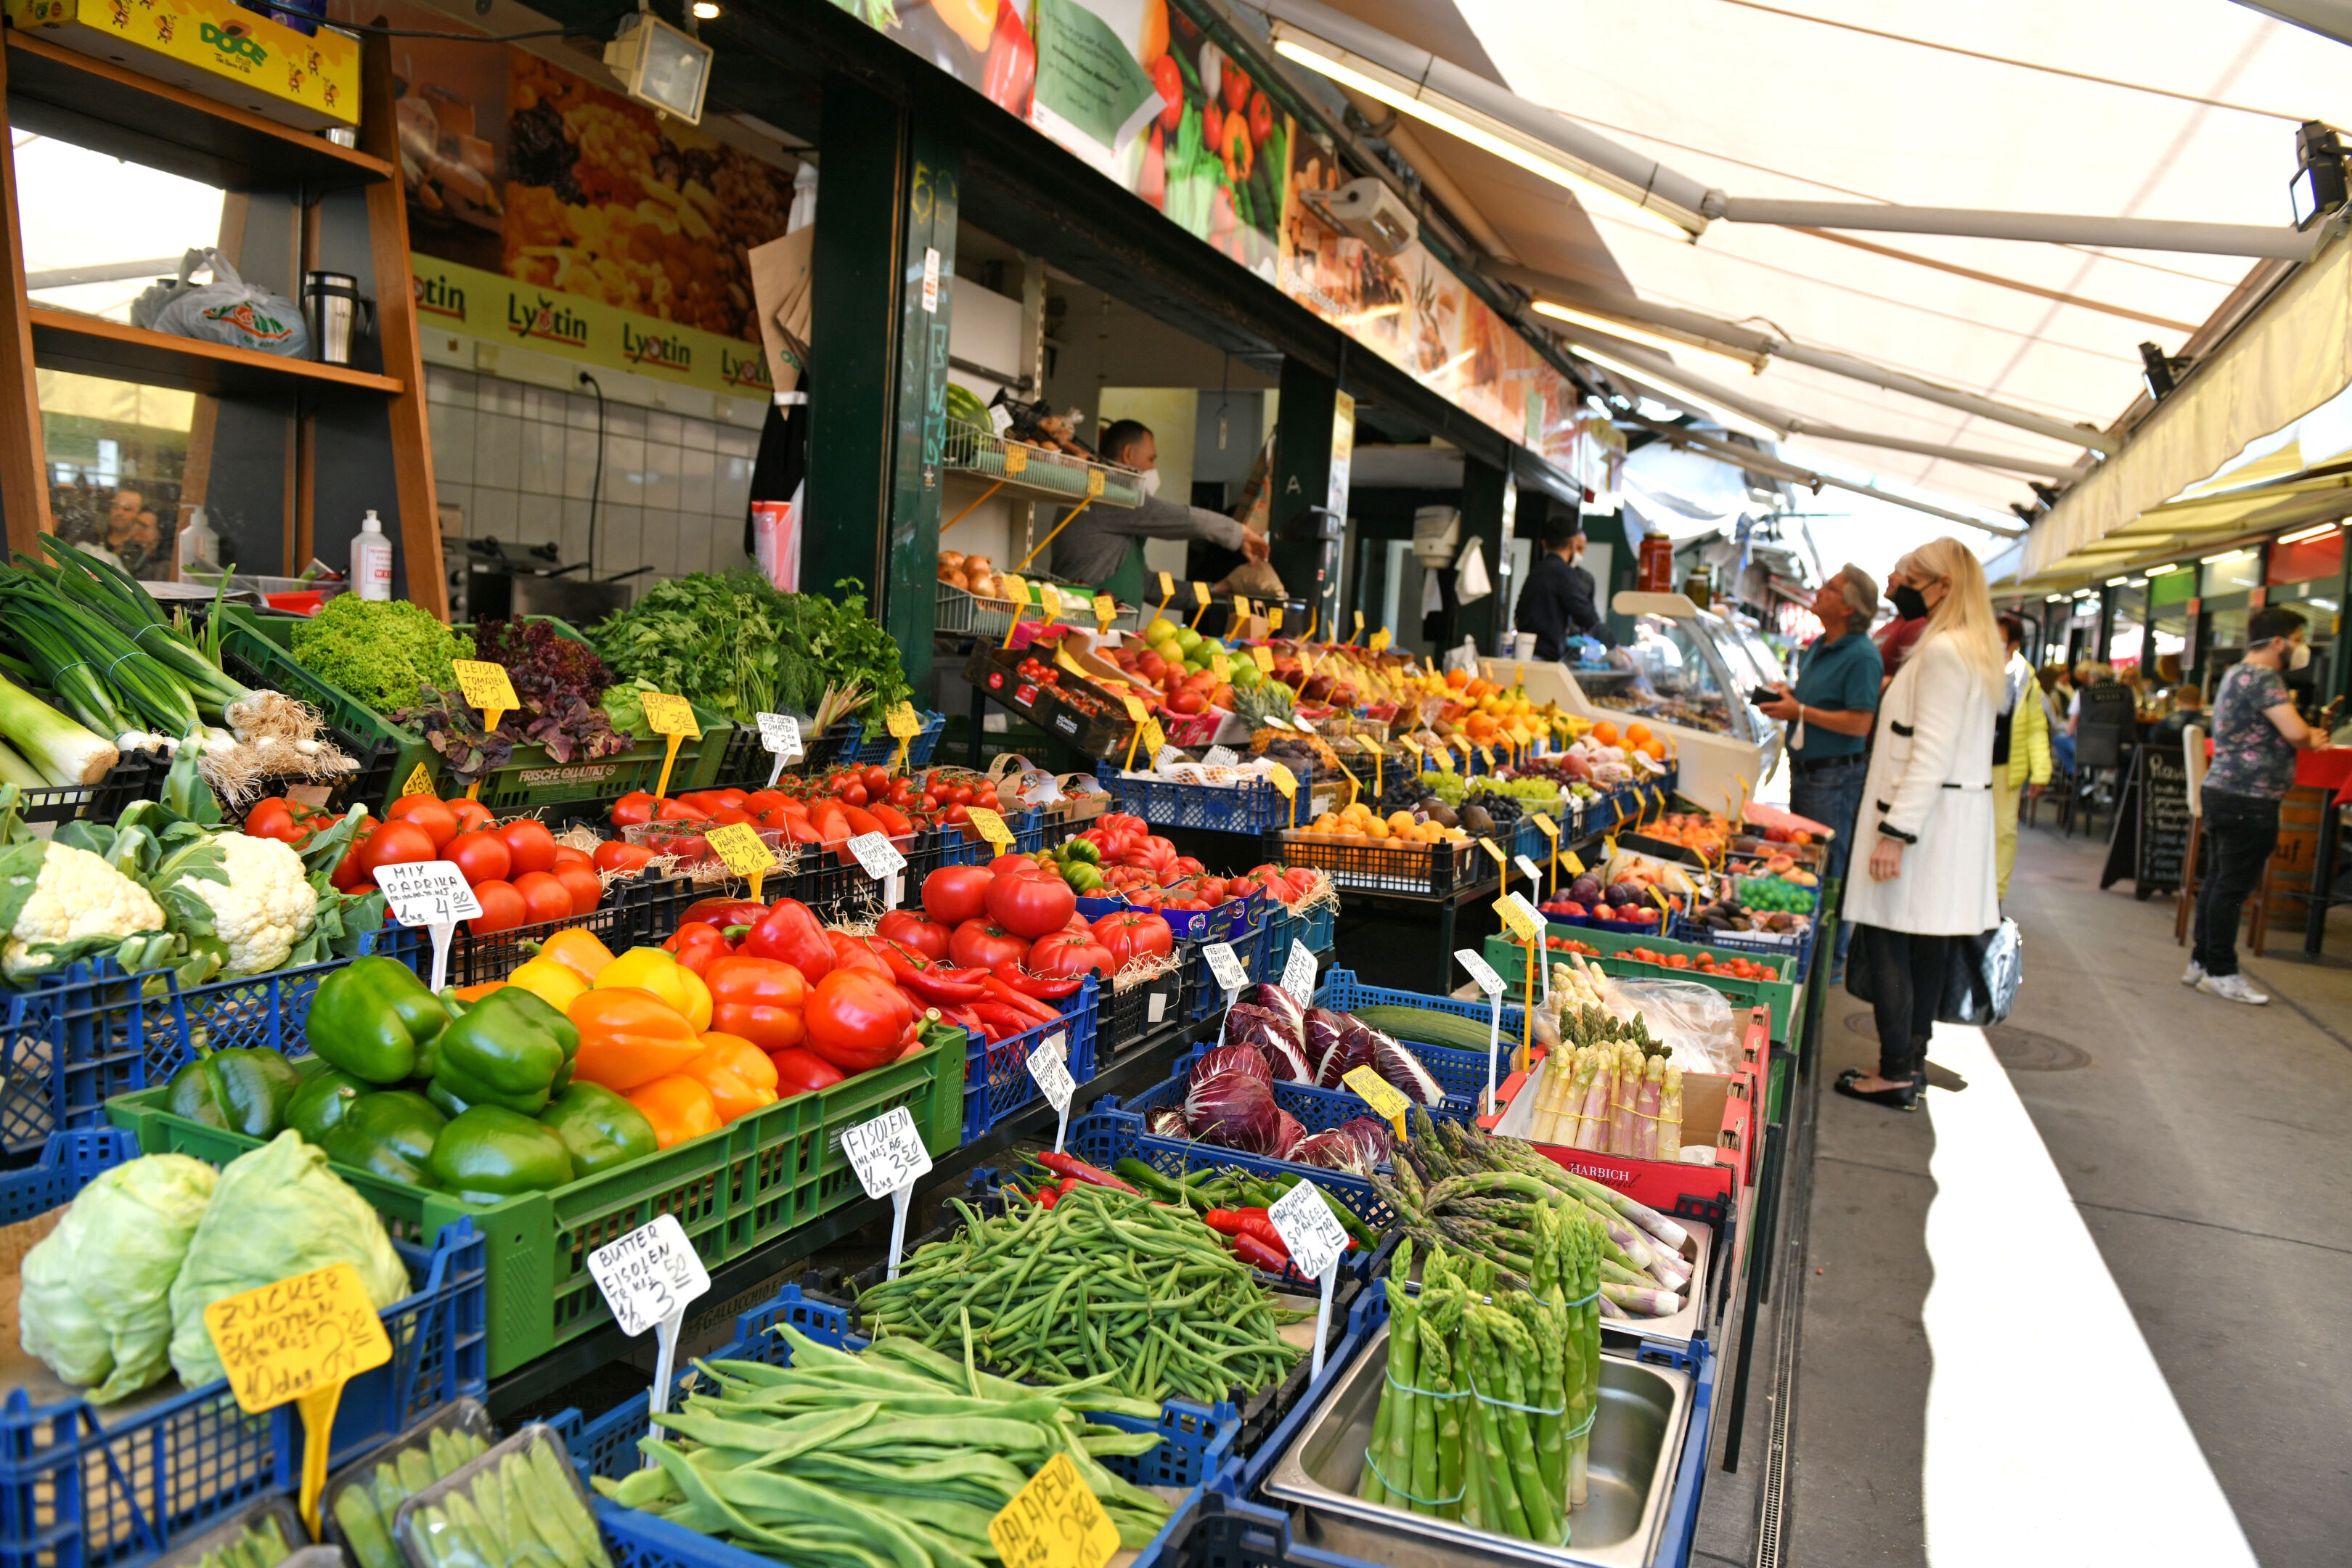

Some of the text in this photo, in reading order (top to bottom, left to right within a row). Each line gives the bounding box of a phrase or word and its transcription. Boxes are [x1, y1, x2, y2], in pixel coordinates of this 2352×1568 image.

[200, 23, 268, 67] DOCE
[457, 660, 501, 676] FLEISCH
[463, 676, 505, 686] TOMATEN
[518, 767, 561, 783] FRISCHE
[717, 833, 748, 849] PAPRIKA
[393, 865, 424, 879] MIX
[387, 875, 457, 894] PAPRIKA
[1205, 945, 1228, 956] TREVISO
[1029, 1055, 1041, 1072] ROT
[846, 1108, 908, 1156] FISOLEN
[1569, 1162, 1630, 1181] HARBICH
[598, 1225, 659, 1268] BUTTER
[219, 1271, 340, 1330] ZUCKER
